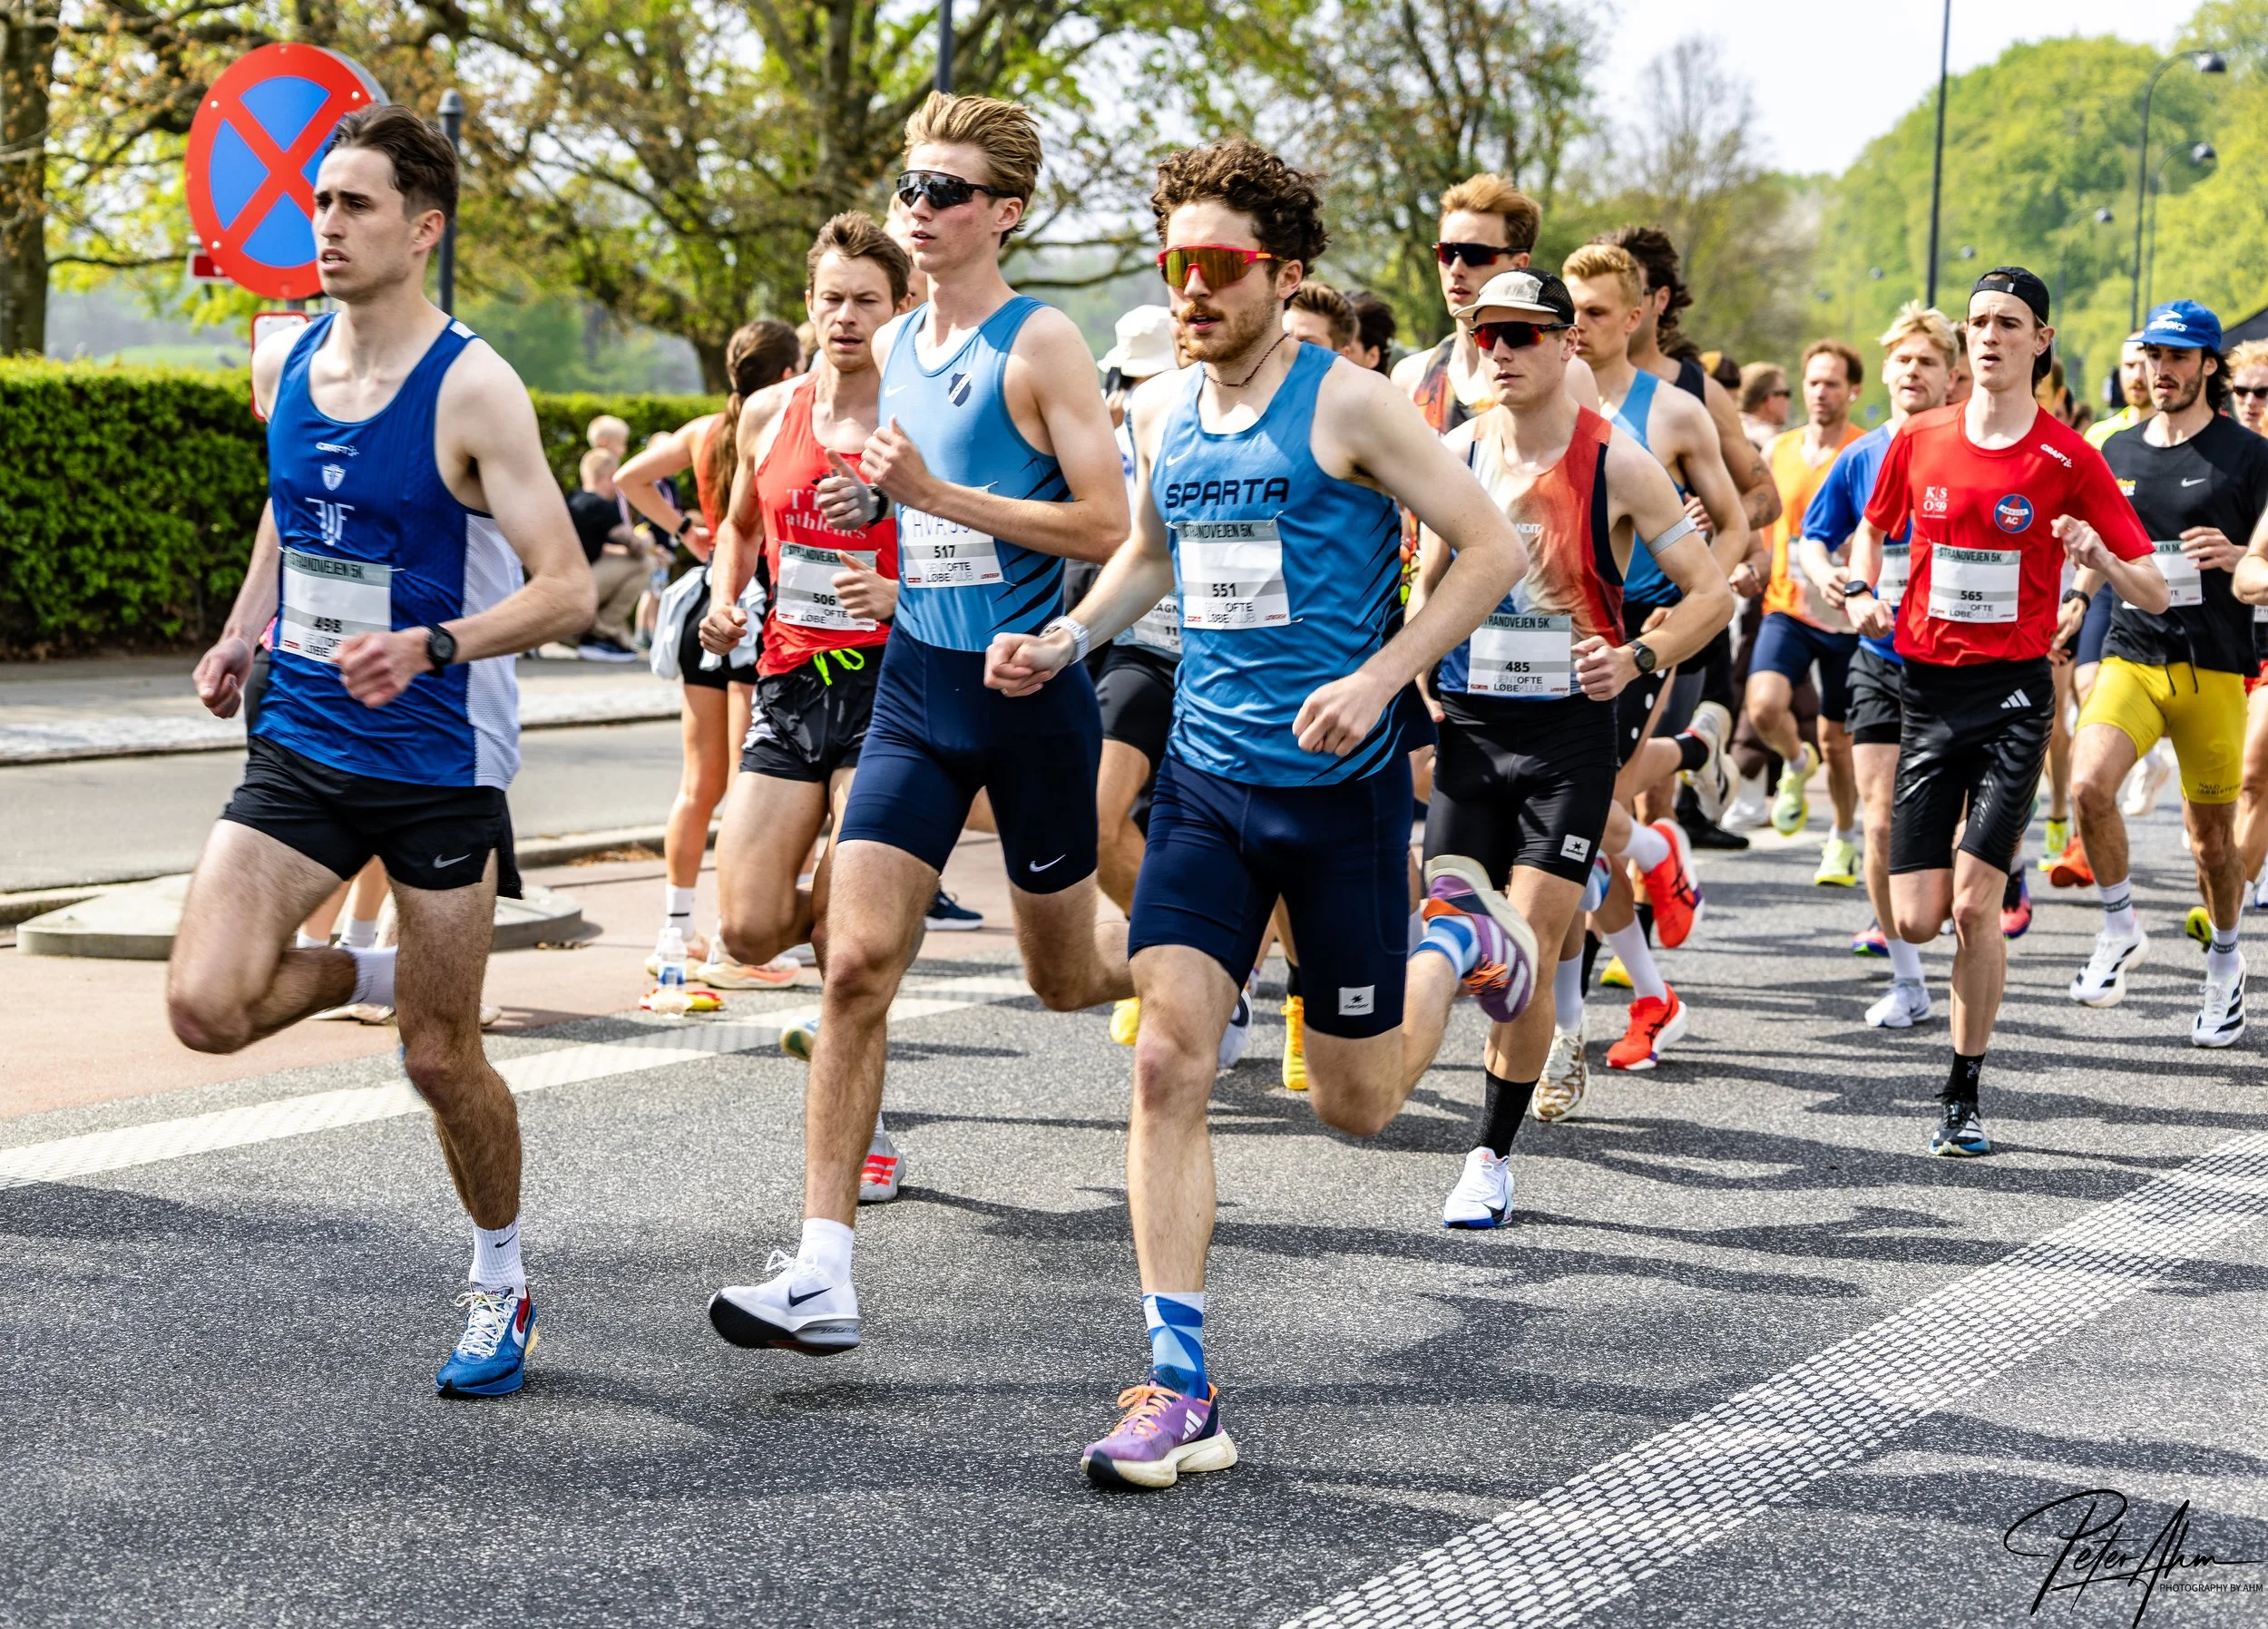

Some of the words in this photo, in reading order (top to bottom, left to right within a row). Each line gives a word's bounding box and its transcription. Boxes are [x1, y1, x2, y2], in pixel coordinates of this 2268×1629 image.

[2040, 444, 2068, 462] CRAFT
[1165, 477, 1290, 509] SPARTA
[2005, 516, 2019, 525] AC
[1182, 523, 1238, 539] STRANDVEJEN
[1240, 523, 1256, 538] 5K
[1516, 522, 1540, 533] NDIT
[934, 545, 955, 559] 517
[1939, 547, 1989, 562] STRANDVEJEN
[1991, 551, 2002, 562] 5K
[1212, 583, 1237, 598] 551
[1960, 590, 1983, 601] 565
[813, 592, 836, 606] 506
[1154, 603, 1180, 614] AGN
[1484, 616, 1536, 629] TRANDVEJEN
[1538, 617, 1550, 629] 5K
[1165, 626, 1178, 637] 11
[1505, 661, 1530, 673] 485
[1493, 683, 1543, 693] LØBEKLUB
